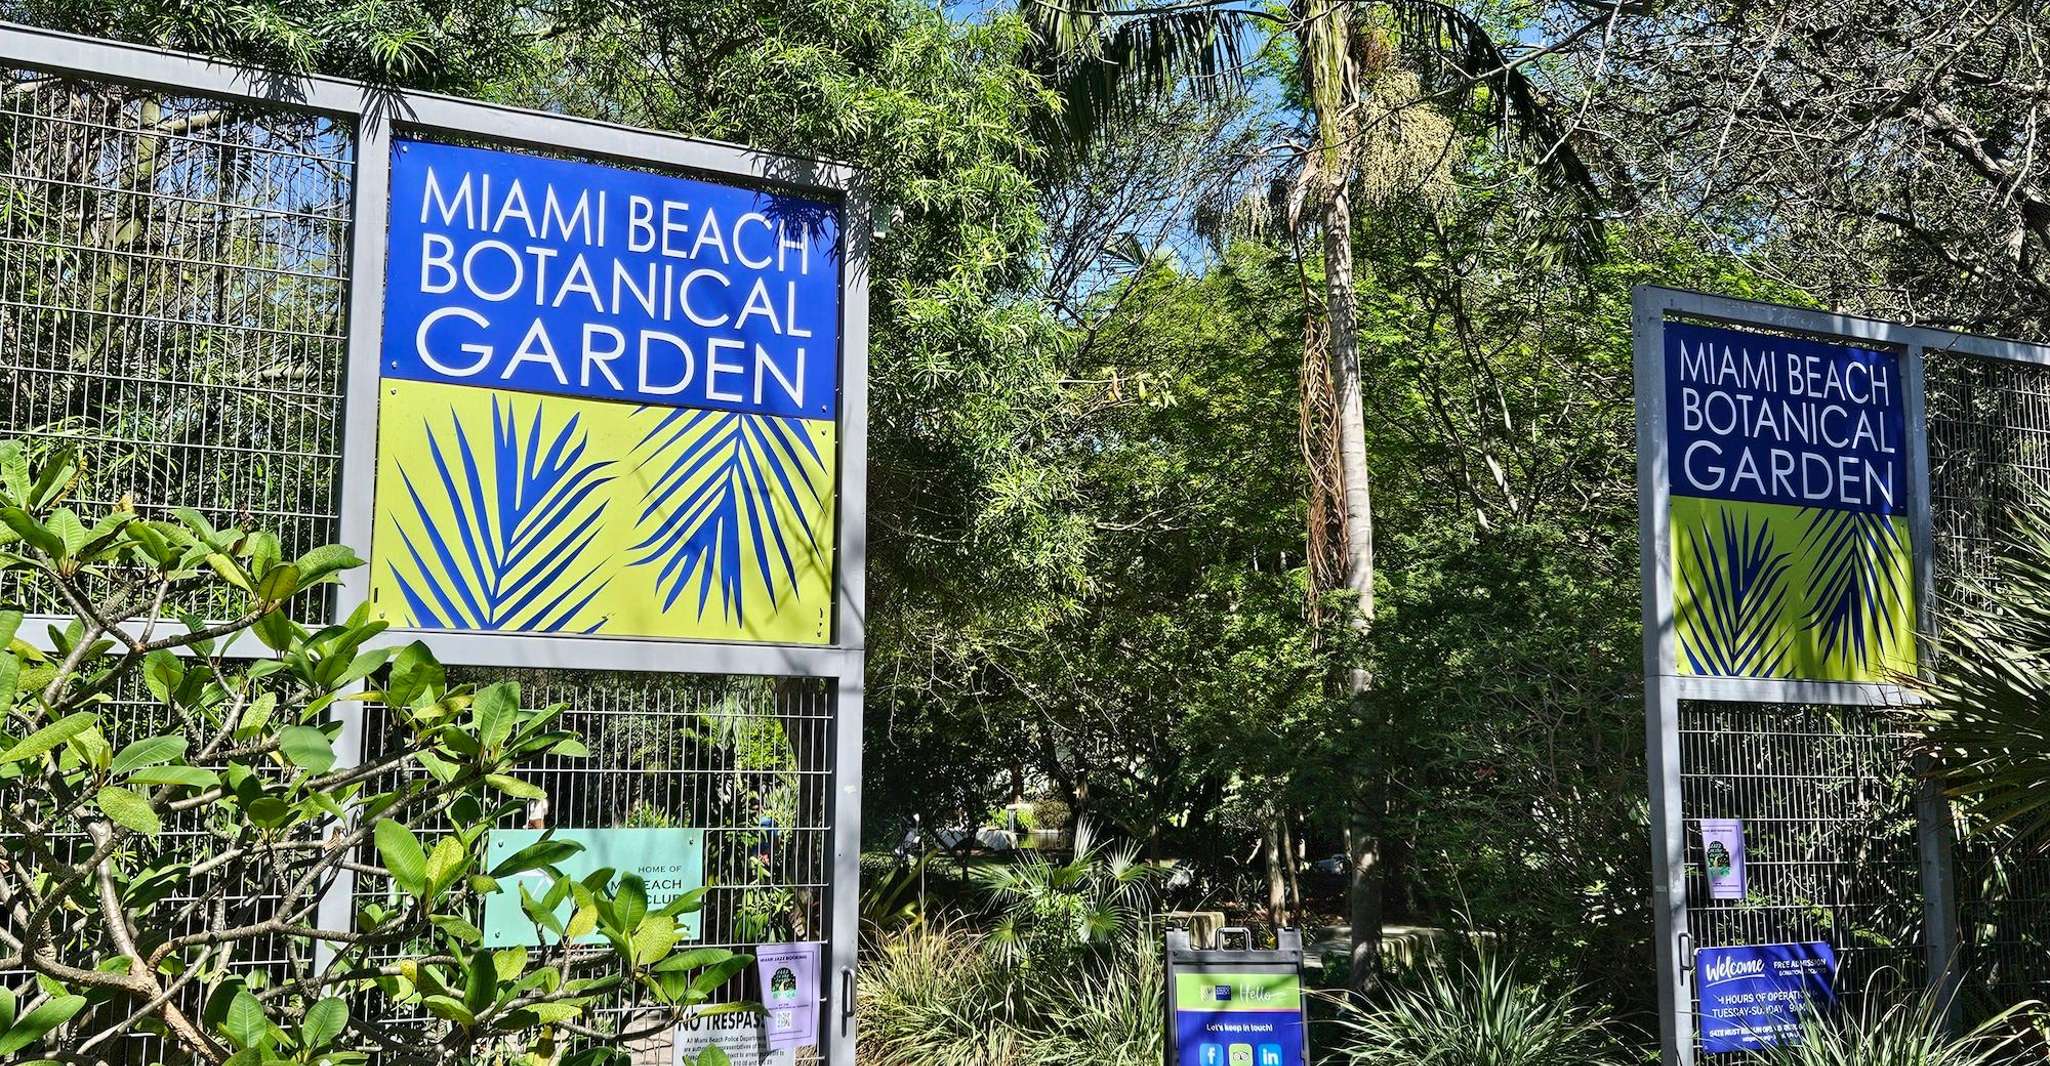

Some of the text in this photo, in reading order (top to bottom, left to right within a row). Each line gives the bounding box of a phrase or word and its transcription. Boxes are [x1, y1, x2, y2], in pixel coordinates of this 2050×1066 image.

[420, 166, 809, 275] MIAMI BEACH
[420, 232, 812, 338] BOTANICAL
[415, 306, 806, 409] GARDEN
[1680, 339, 1889, 406] MIAMI BEACH
[1682, 387, 1895, 454] BOTANICAL
[1684, 440, 1893, 507] GARDEN
[643, 879, 682, 890] EACH
[1706, 955, 1765, 983] Welcome
[1725, 993, 1754, 1005] HOURS
[1755, 991, 1766, 1002] OF
[678, 1012, 700, 1031] NO
[1262, 1047, 1279, 1066] in
